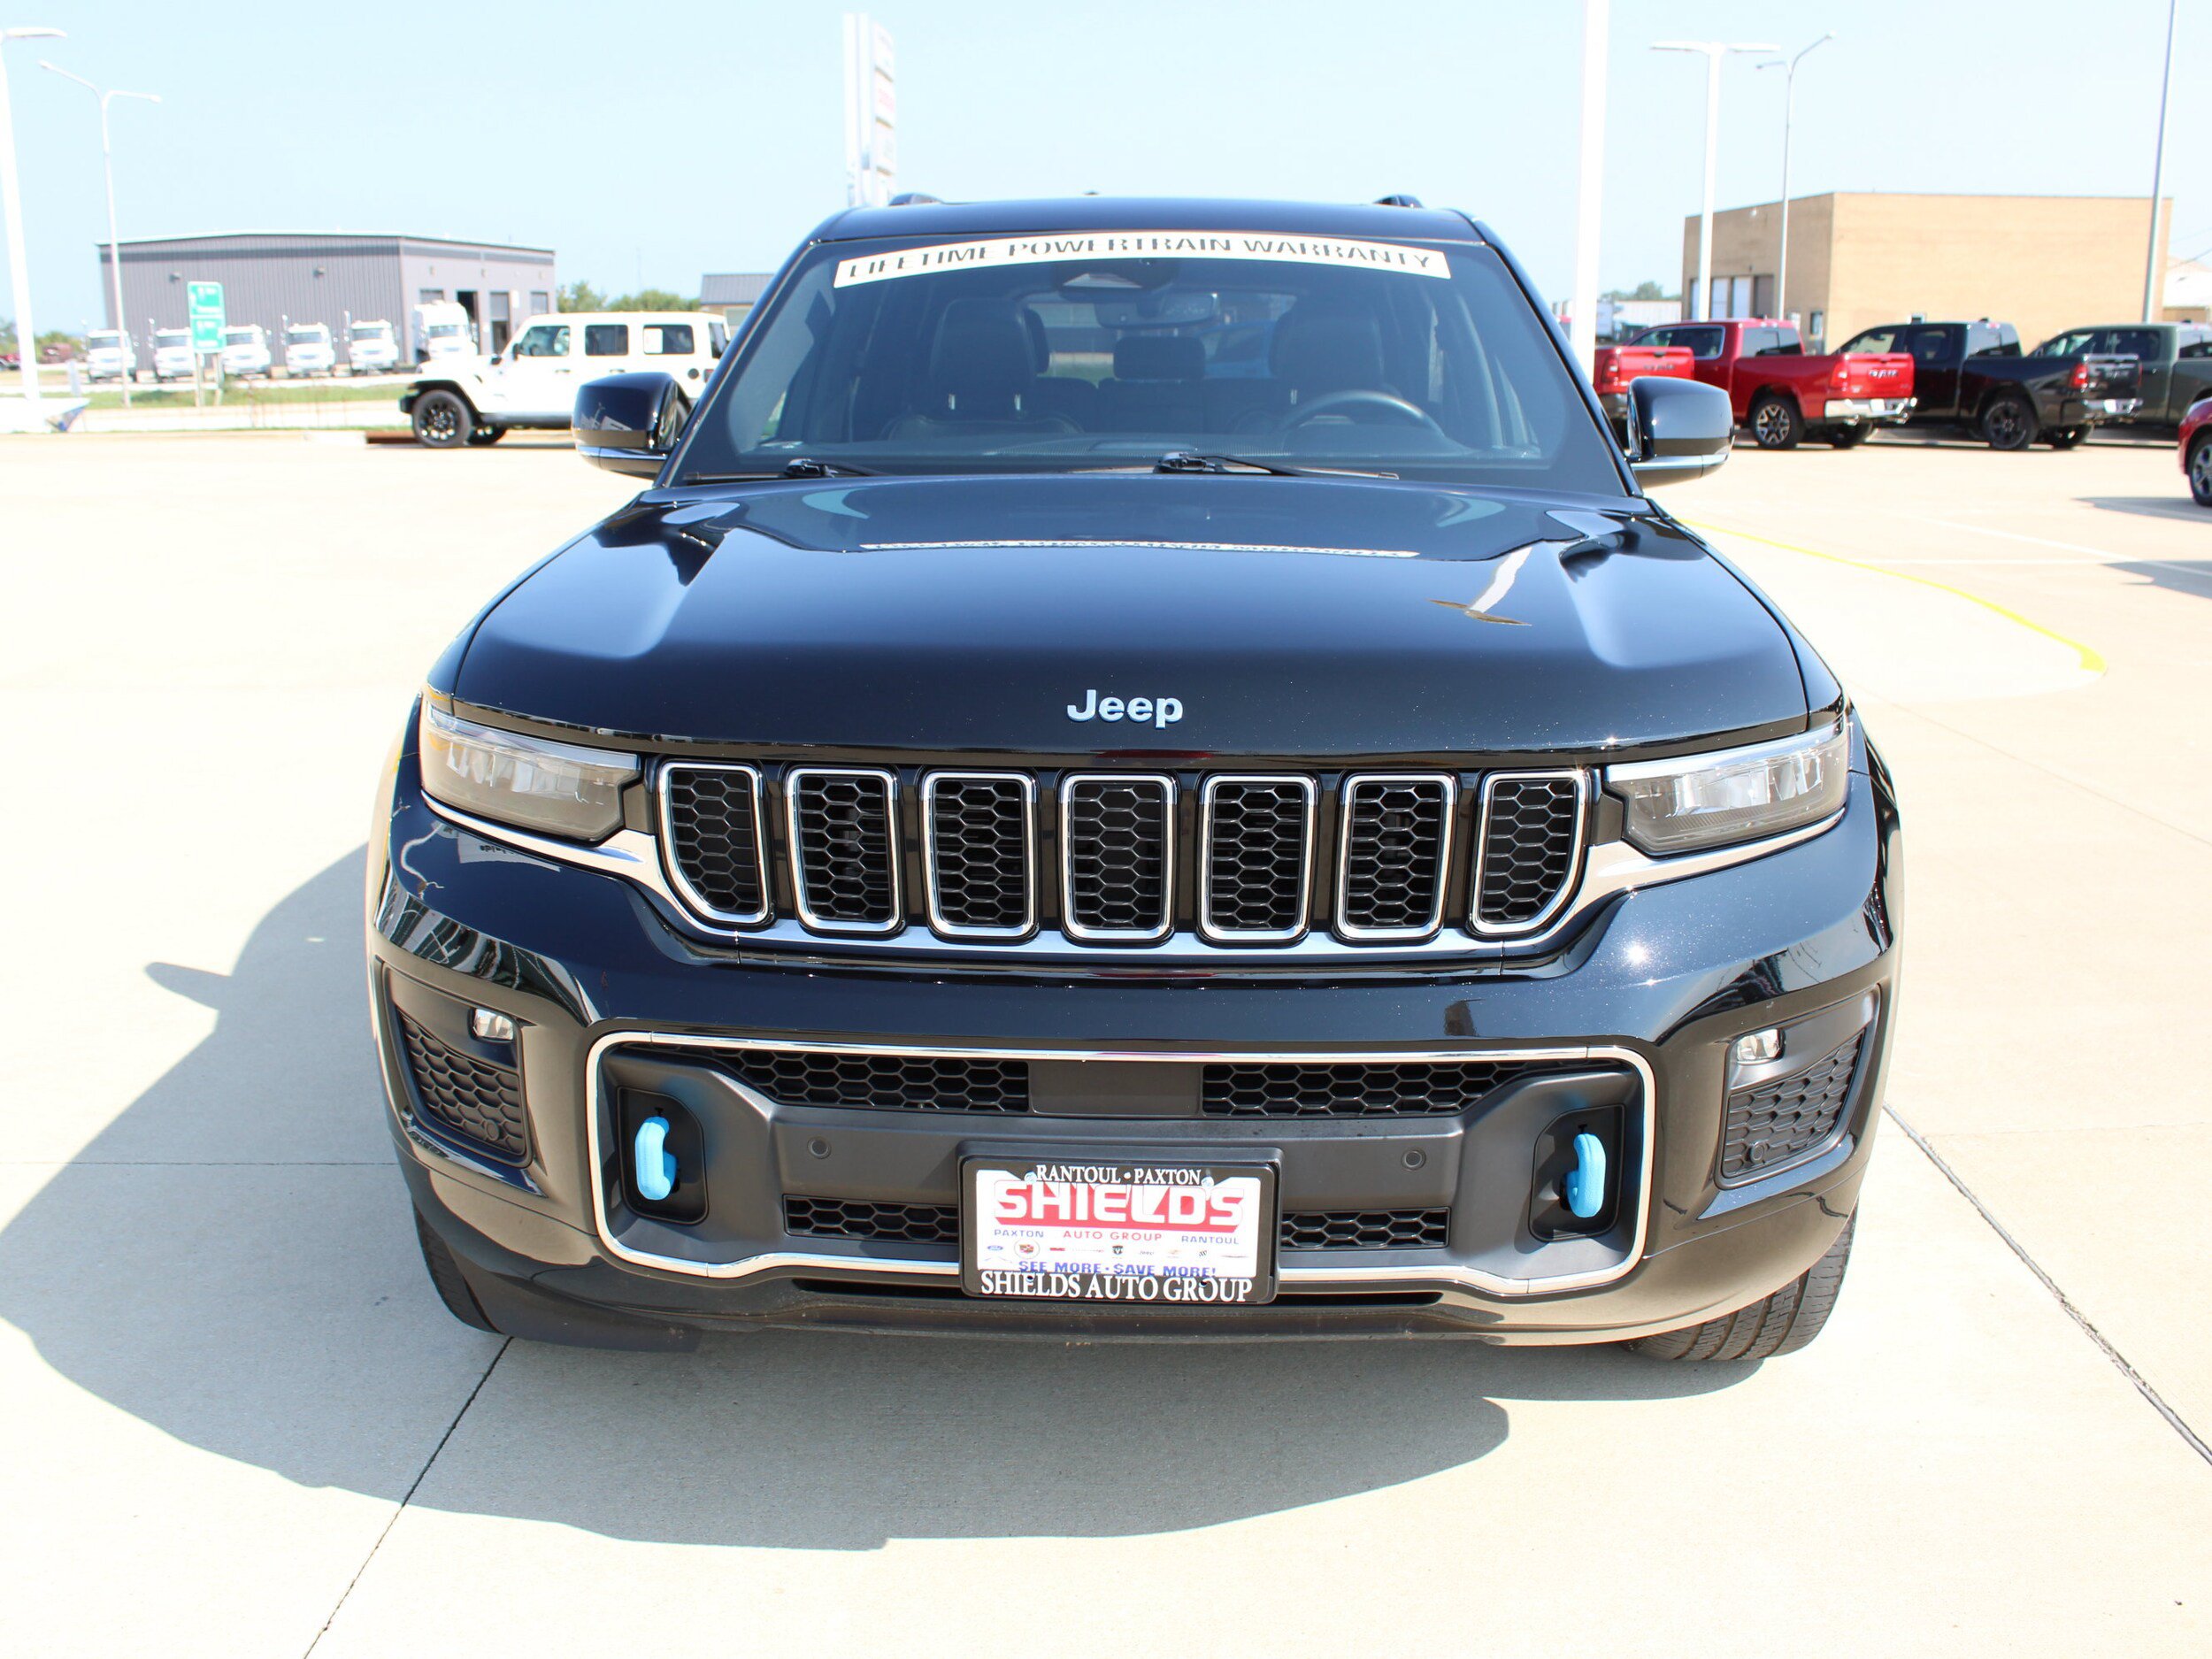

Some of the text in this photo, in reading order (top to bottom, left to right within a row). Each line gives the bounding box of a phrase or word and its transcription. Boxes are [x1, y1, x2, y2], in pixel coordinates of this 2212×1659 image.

[850, 238, 1429, 277] LIFETIME POWERTRAIN WARRANTY
[1067, 689, 1183, 729] Jeep
[1036, 1164, 1201, 1185] RANTOUL PAXTON
[995, 1180, 1244, 1232] SHIELDS
[995, 1229, 1044, 1238] PAXTON
[1064, 1230, 1162, 1241] AUTO GROUP
[1181, 1235, 1240, 1245] RANTOUL
[1055, 1262, 1102, 1273] MORE
[1163, 1266, 1217, 1277] MORE!
[981, 1270, 1252, 1302] SHIELDS AUTO GROUP
